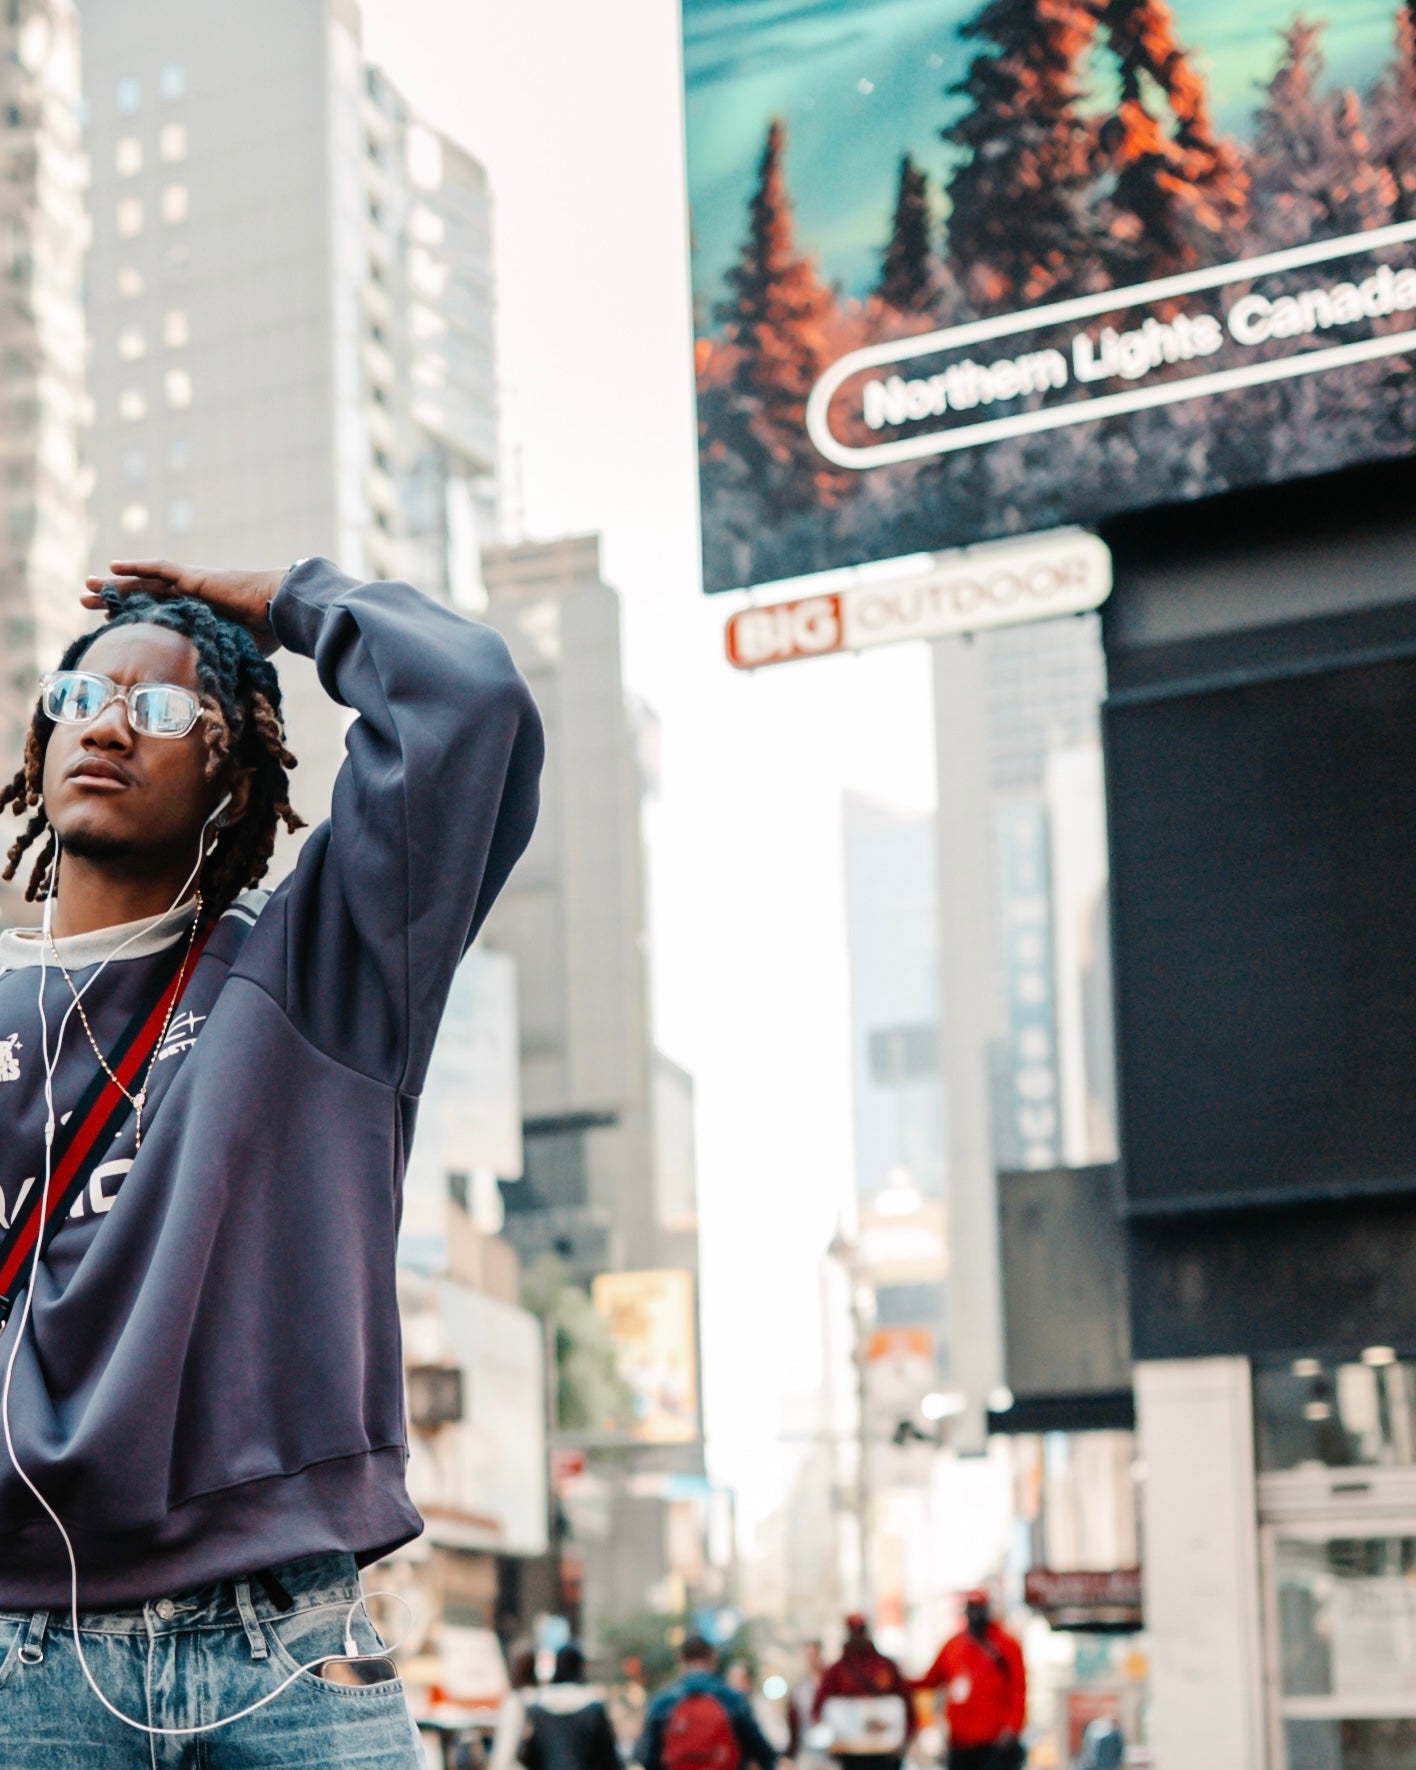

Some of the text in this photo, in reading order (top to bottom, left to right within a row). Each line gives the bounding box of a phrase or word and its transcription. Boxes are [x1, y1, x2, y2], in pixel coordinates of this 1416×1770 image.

[863, 347, 1068, 431] Northern
[1072, 312, 1223, 384] Lights
[737, 554, 1091, 664] BIG OUTDOOR
